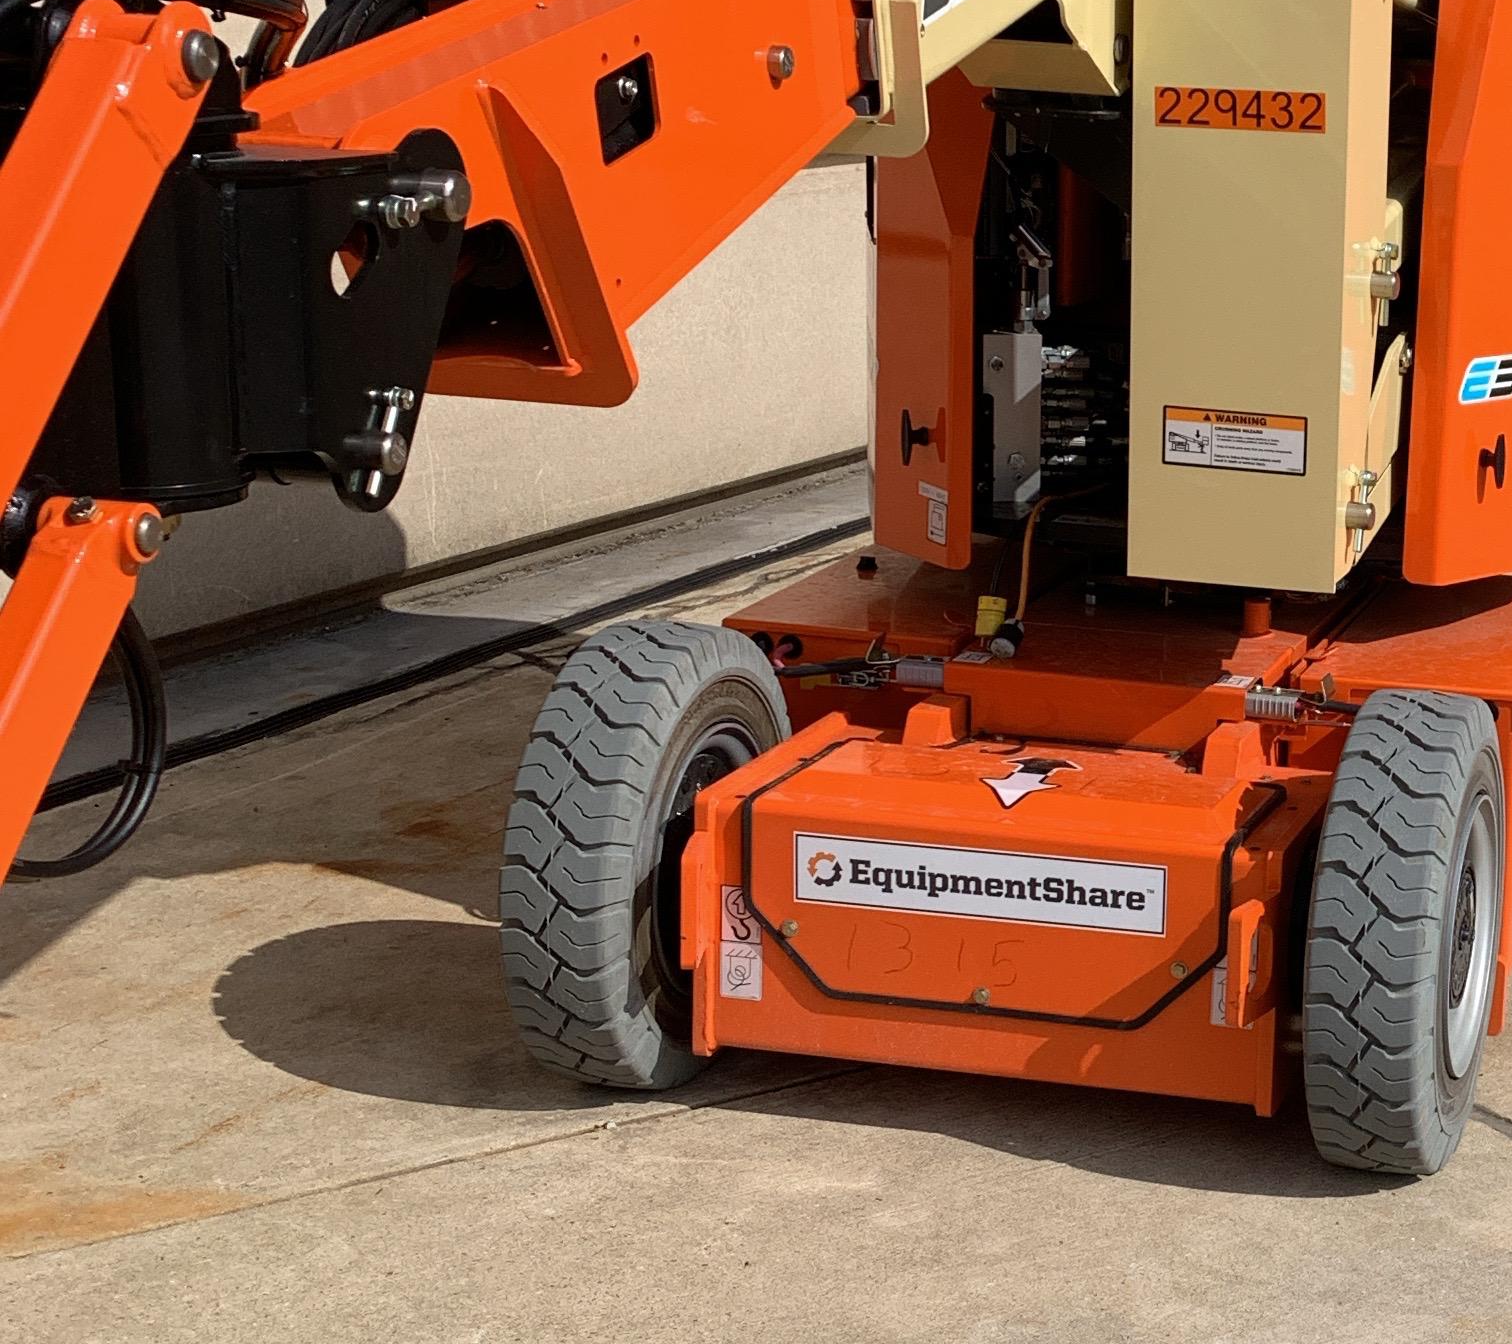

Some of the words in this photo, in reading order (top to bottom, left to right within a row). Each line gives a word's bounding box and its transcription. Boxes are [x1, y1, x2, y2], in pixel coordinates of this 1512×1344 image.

[1158, 86, 1324, 130] 229432
[1215, 413, 1267, 426] WARNING
[849, 858, 1146, 912] EquipmentShare
